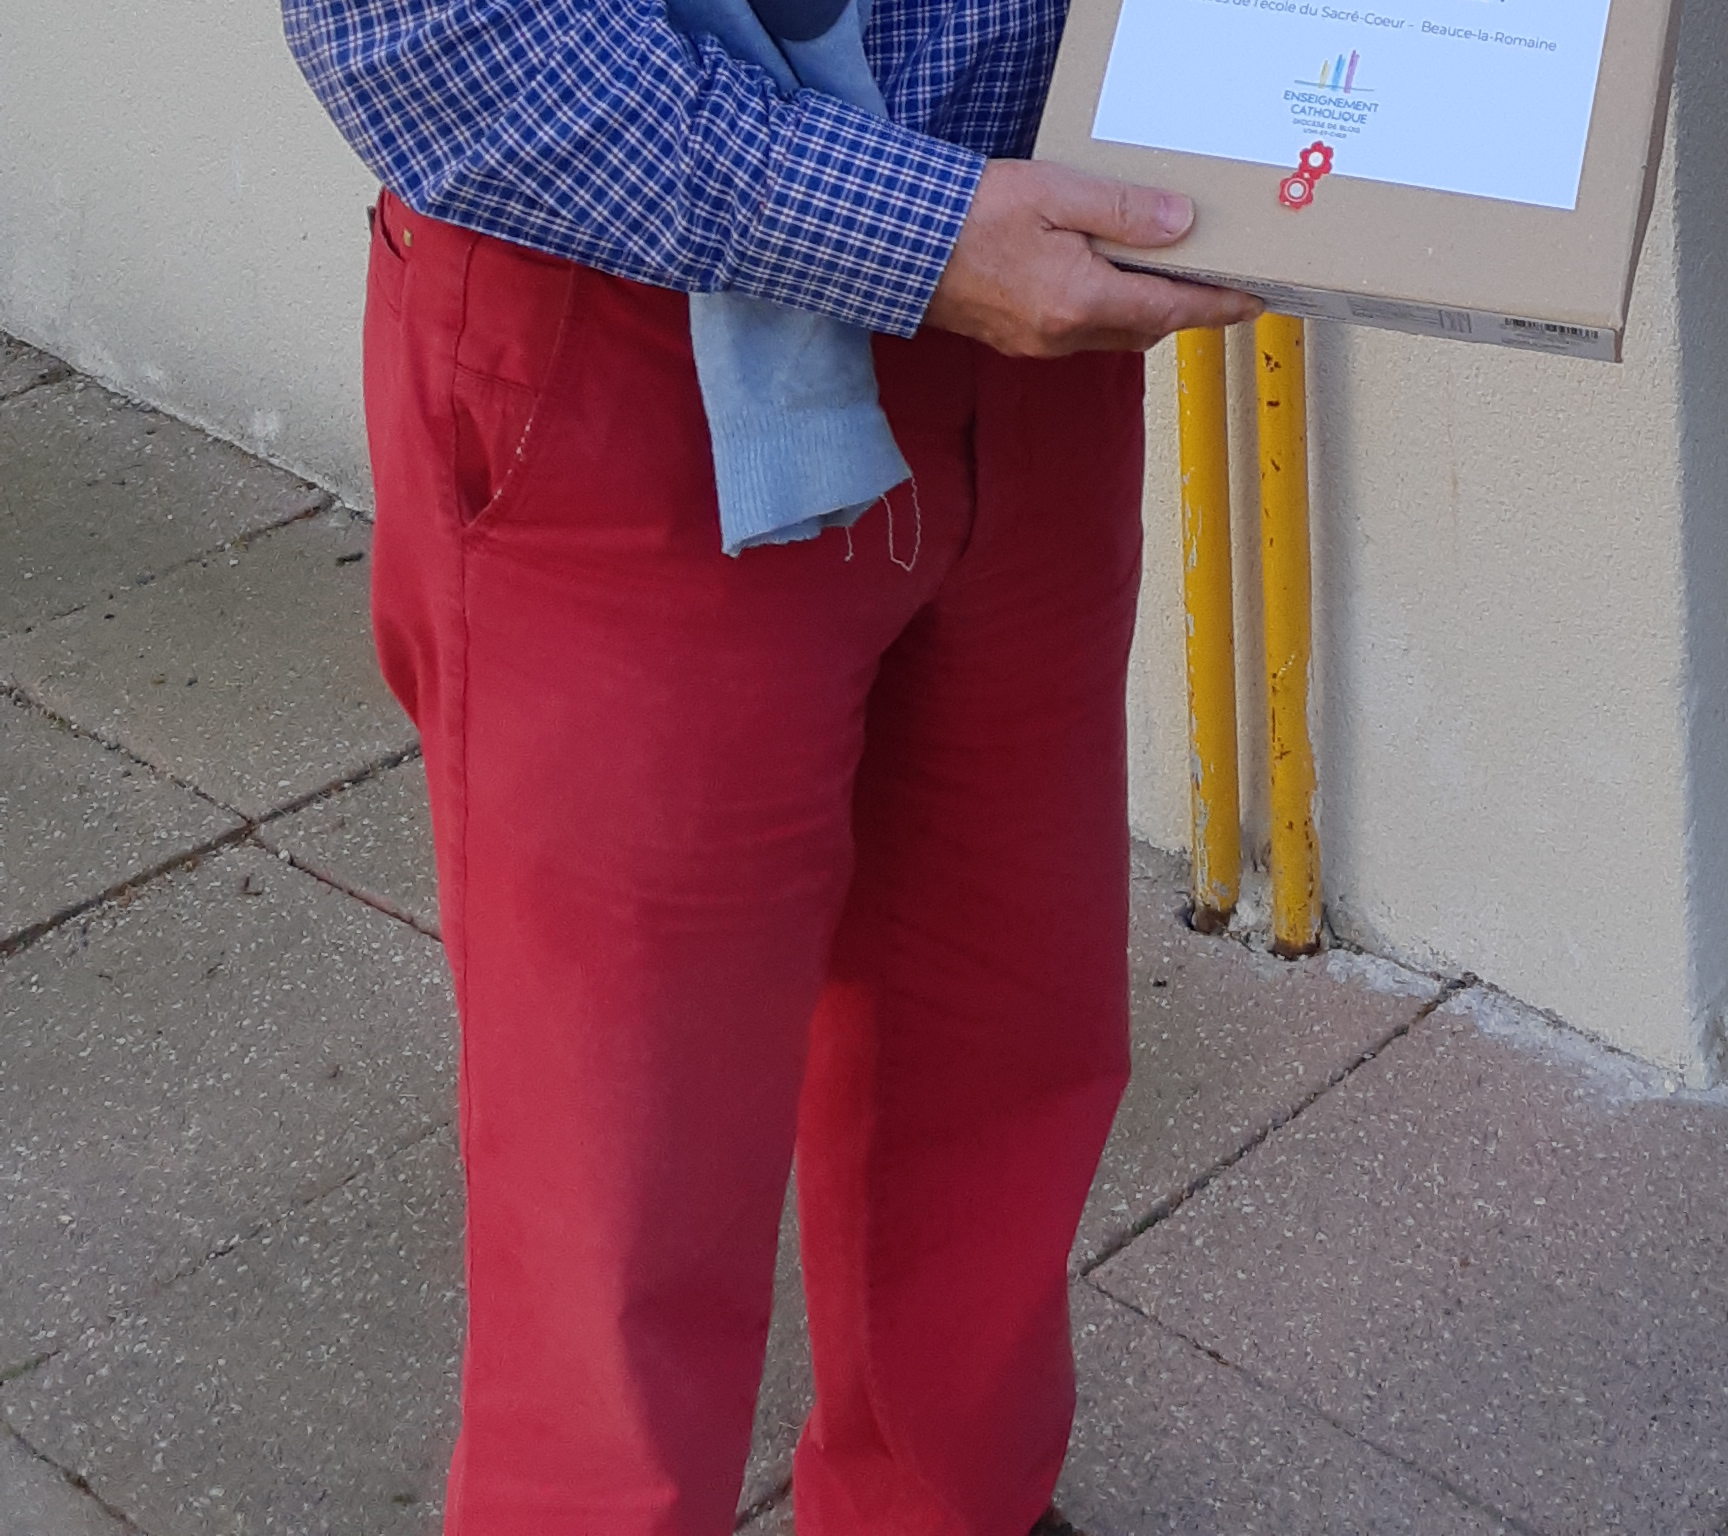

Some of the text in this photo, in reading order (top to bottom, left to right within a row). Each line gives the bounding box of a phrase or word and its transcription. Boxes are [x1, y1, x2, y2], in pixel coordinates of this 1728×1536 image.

[1299, 2, 1318, 16] du
[1320, 6, 1405, 29] Sacré-Coeur
[1421, 19, 1558, 52] Beauce-la-Romaine
[1283, 89, 1379, 113] ENSEIGNEMENT
[1290, 103, 1368, 125] CATHOLIQUE
